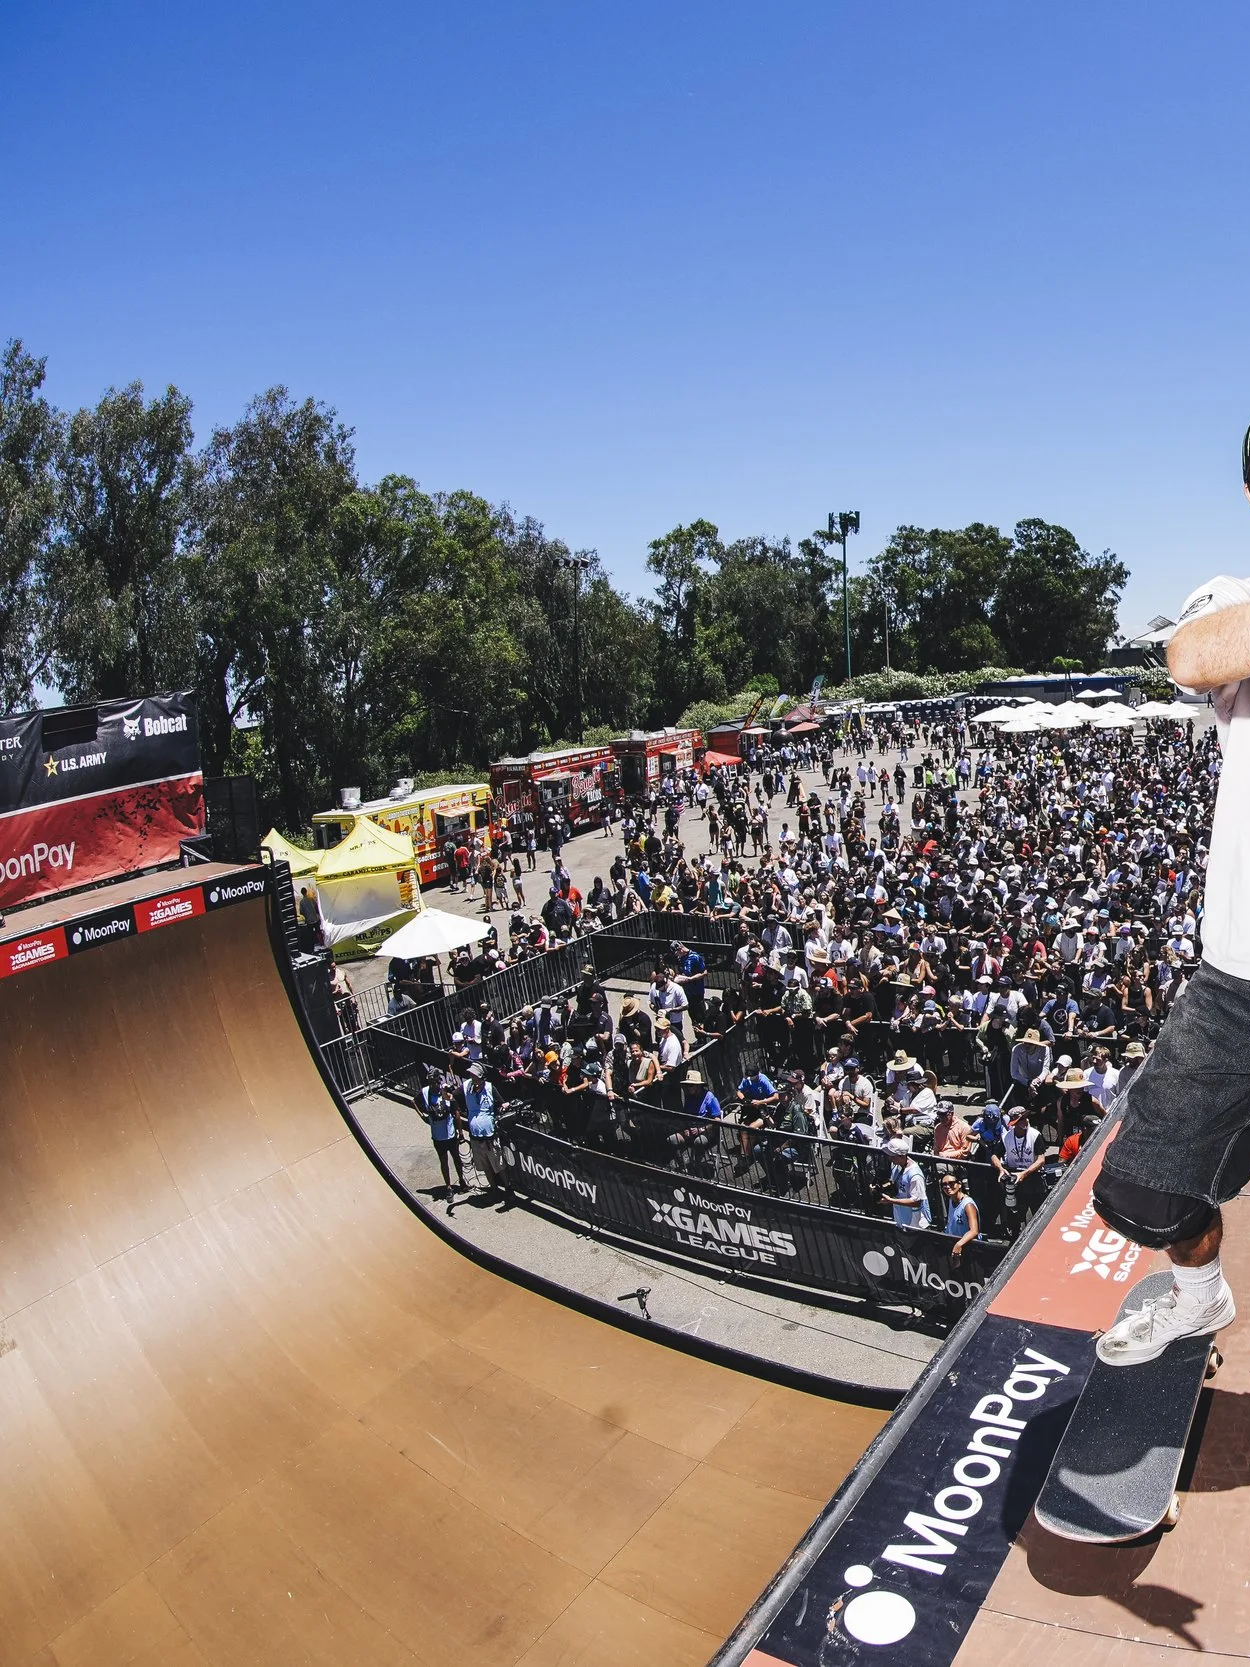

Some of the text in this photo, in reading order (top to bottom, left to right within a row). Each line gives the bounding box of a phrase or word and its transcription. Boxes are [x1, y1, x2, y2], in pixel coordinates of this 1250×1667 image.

[144, 713, 188, 737] Bobcat
[61, 752, 107, 772] U.S. ARMY
[221, 880, 265, 900] MoonPay
[149, 901, 193, 921] XGAMES
[84, 919, 130, 942] MoonPay
[10, 943, 55, 966] XGAMES
[519, 1151, 597, 1204] MoonPay
[688, 1192, 752, 1222] MoonPay
[646, 1197, 798, 1257] XGAMES
[675, 1231, 777, 1266] LEAGUE
[901, 1256, 991, 1300] Moon
[880, 1347, 1071, 1576] MoonPay
